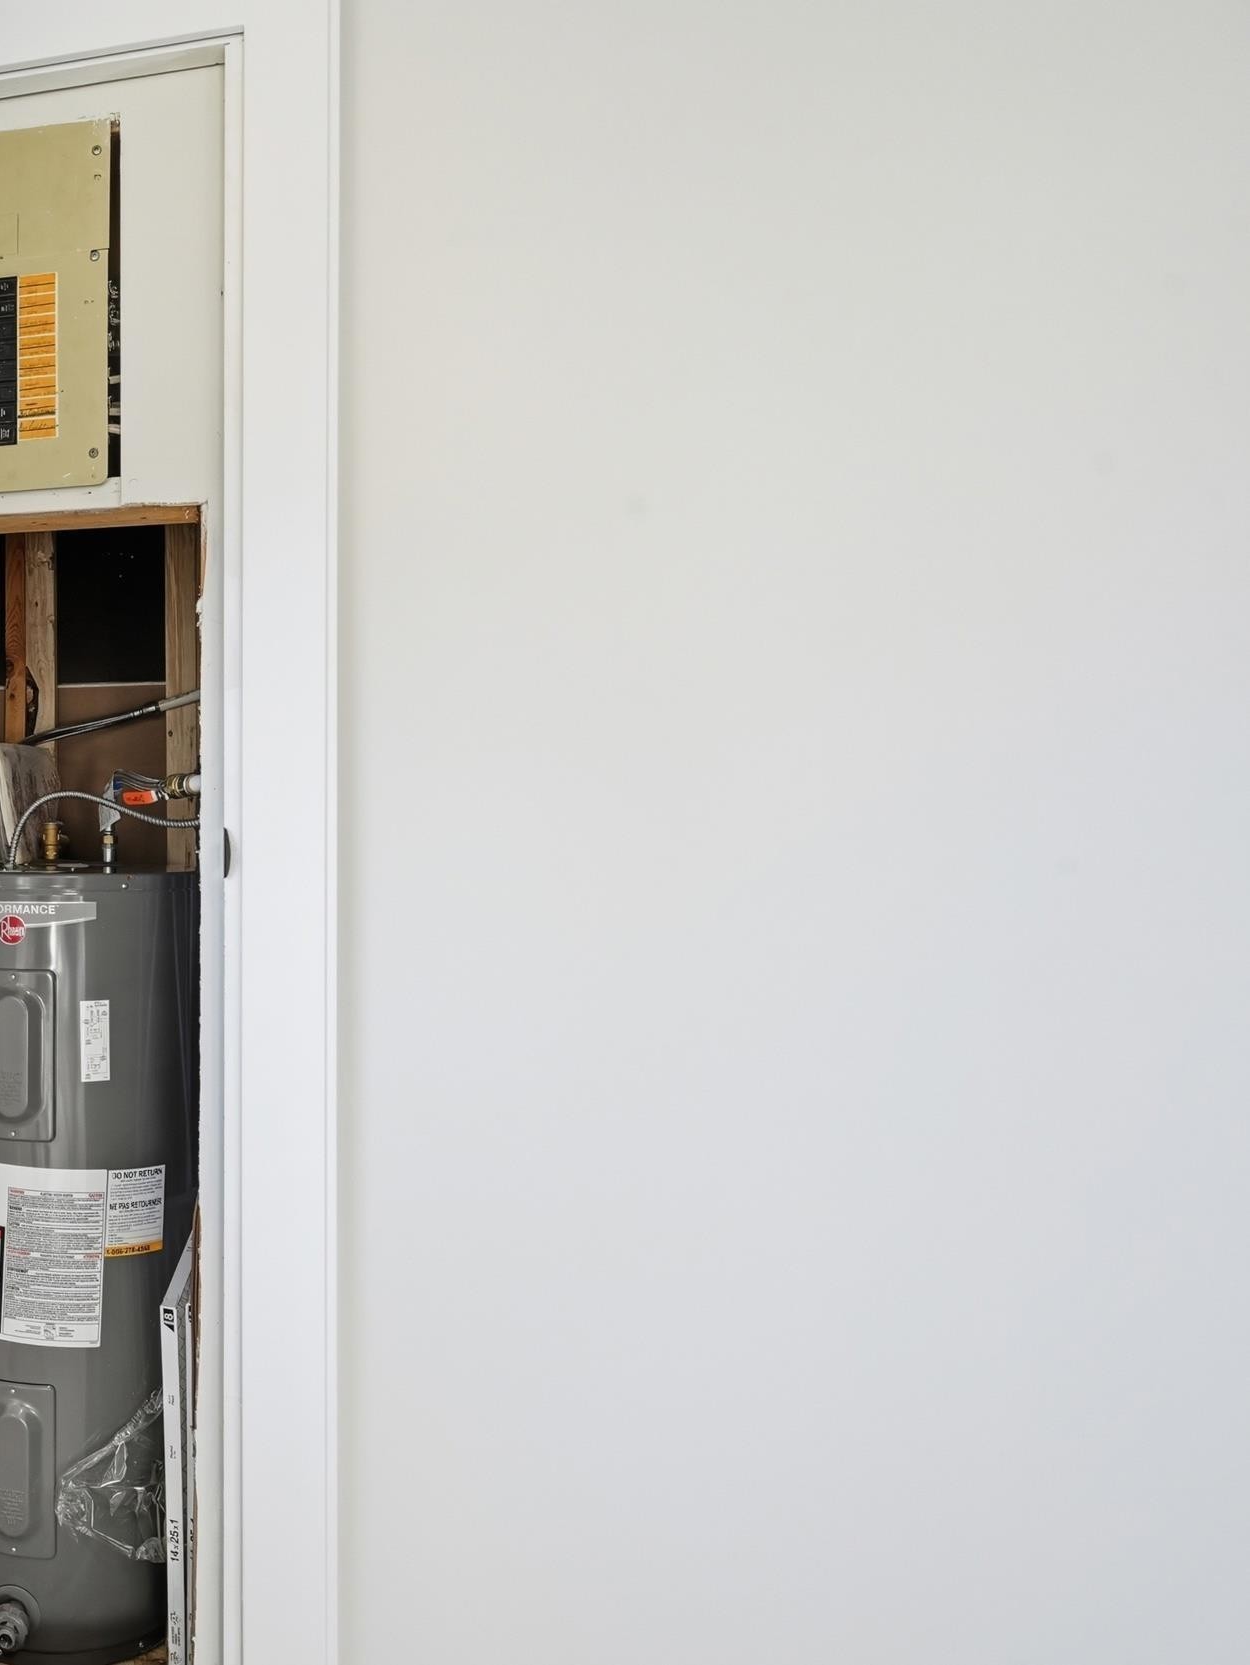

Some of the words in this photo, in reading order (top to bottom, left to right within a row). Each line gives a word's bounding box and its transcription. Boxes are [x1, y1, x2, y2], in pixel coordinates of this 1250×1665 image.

[124, 1171, 137, 1179] NOT
[139, 1168, 163, 1177] RETURN
[119, 1202, 129, 1210] PAS
